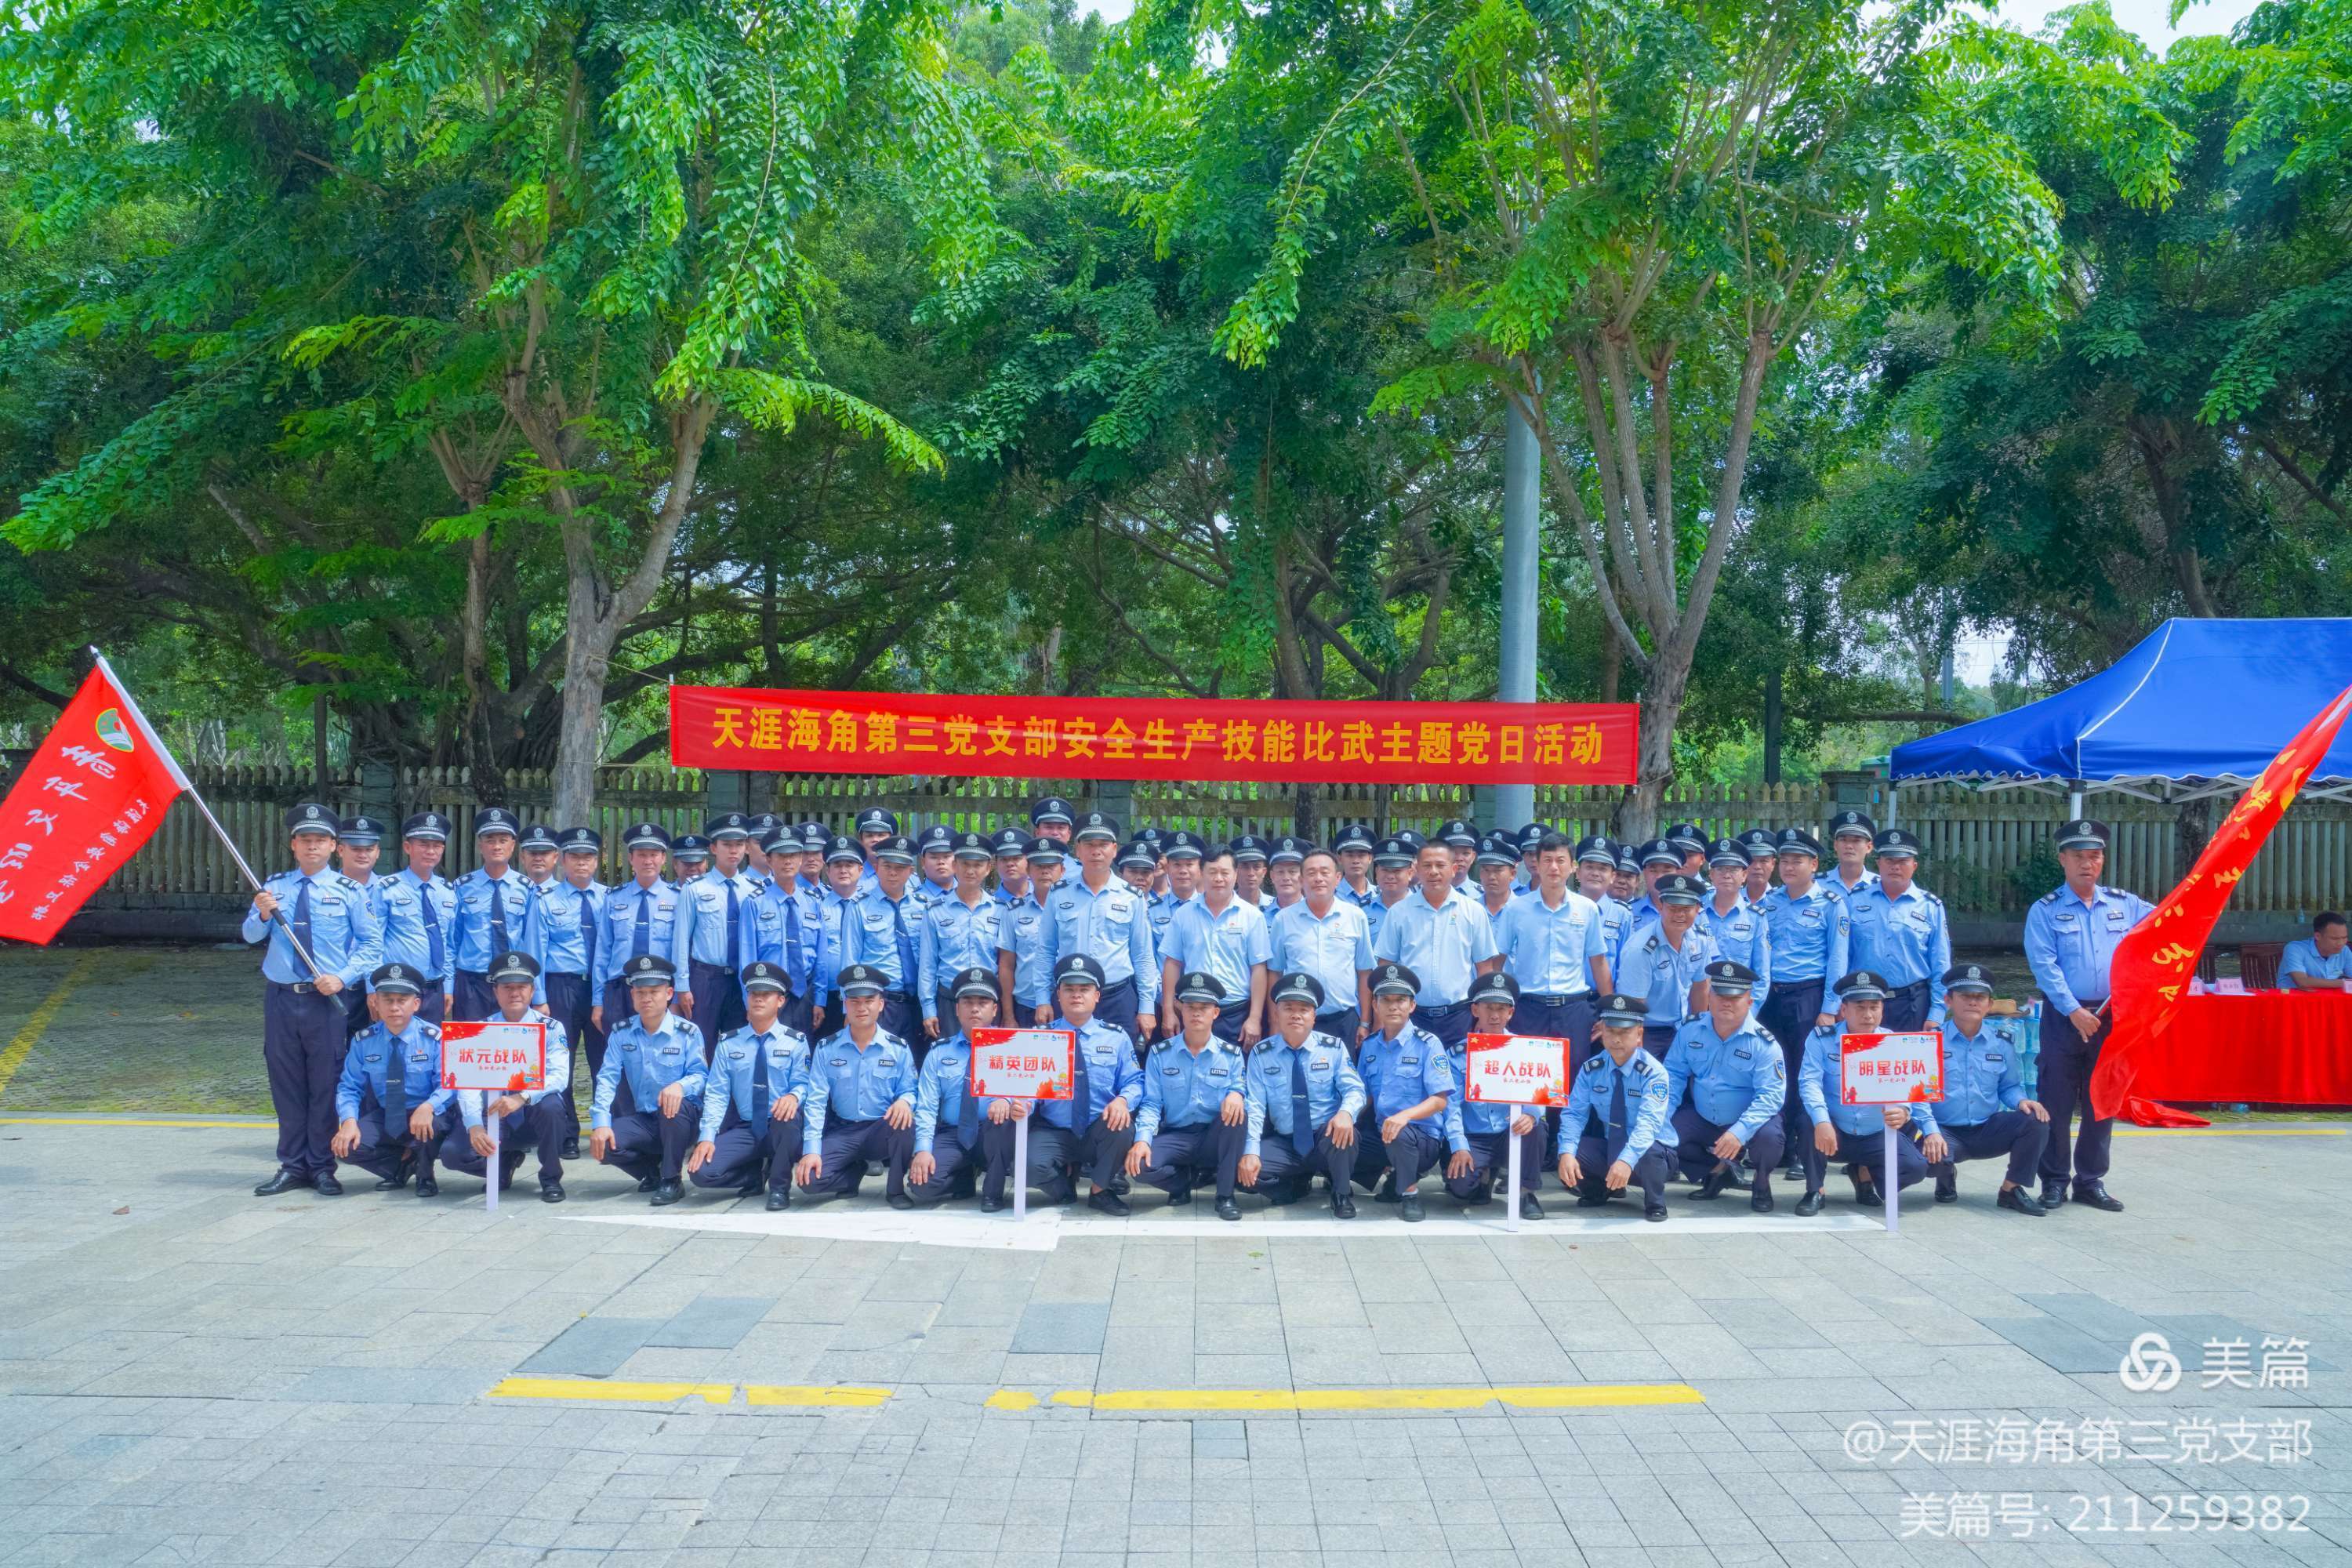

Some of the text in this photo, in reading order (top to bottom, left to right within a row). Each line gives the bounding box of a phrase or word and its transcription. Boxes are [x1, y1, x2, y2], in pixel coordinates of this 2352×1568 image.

[712, 706, 1602, 765] 天涯海角第三党支部安全生产技能比武主题党日活动
[989, 1054, 1056, 1072] 精英团队
[1484, 1060, 1552, 1078] 超人战队
[1859, 1059, 1926, 1076] 明星战队
